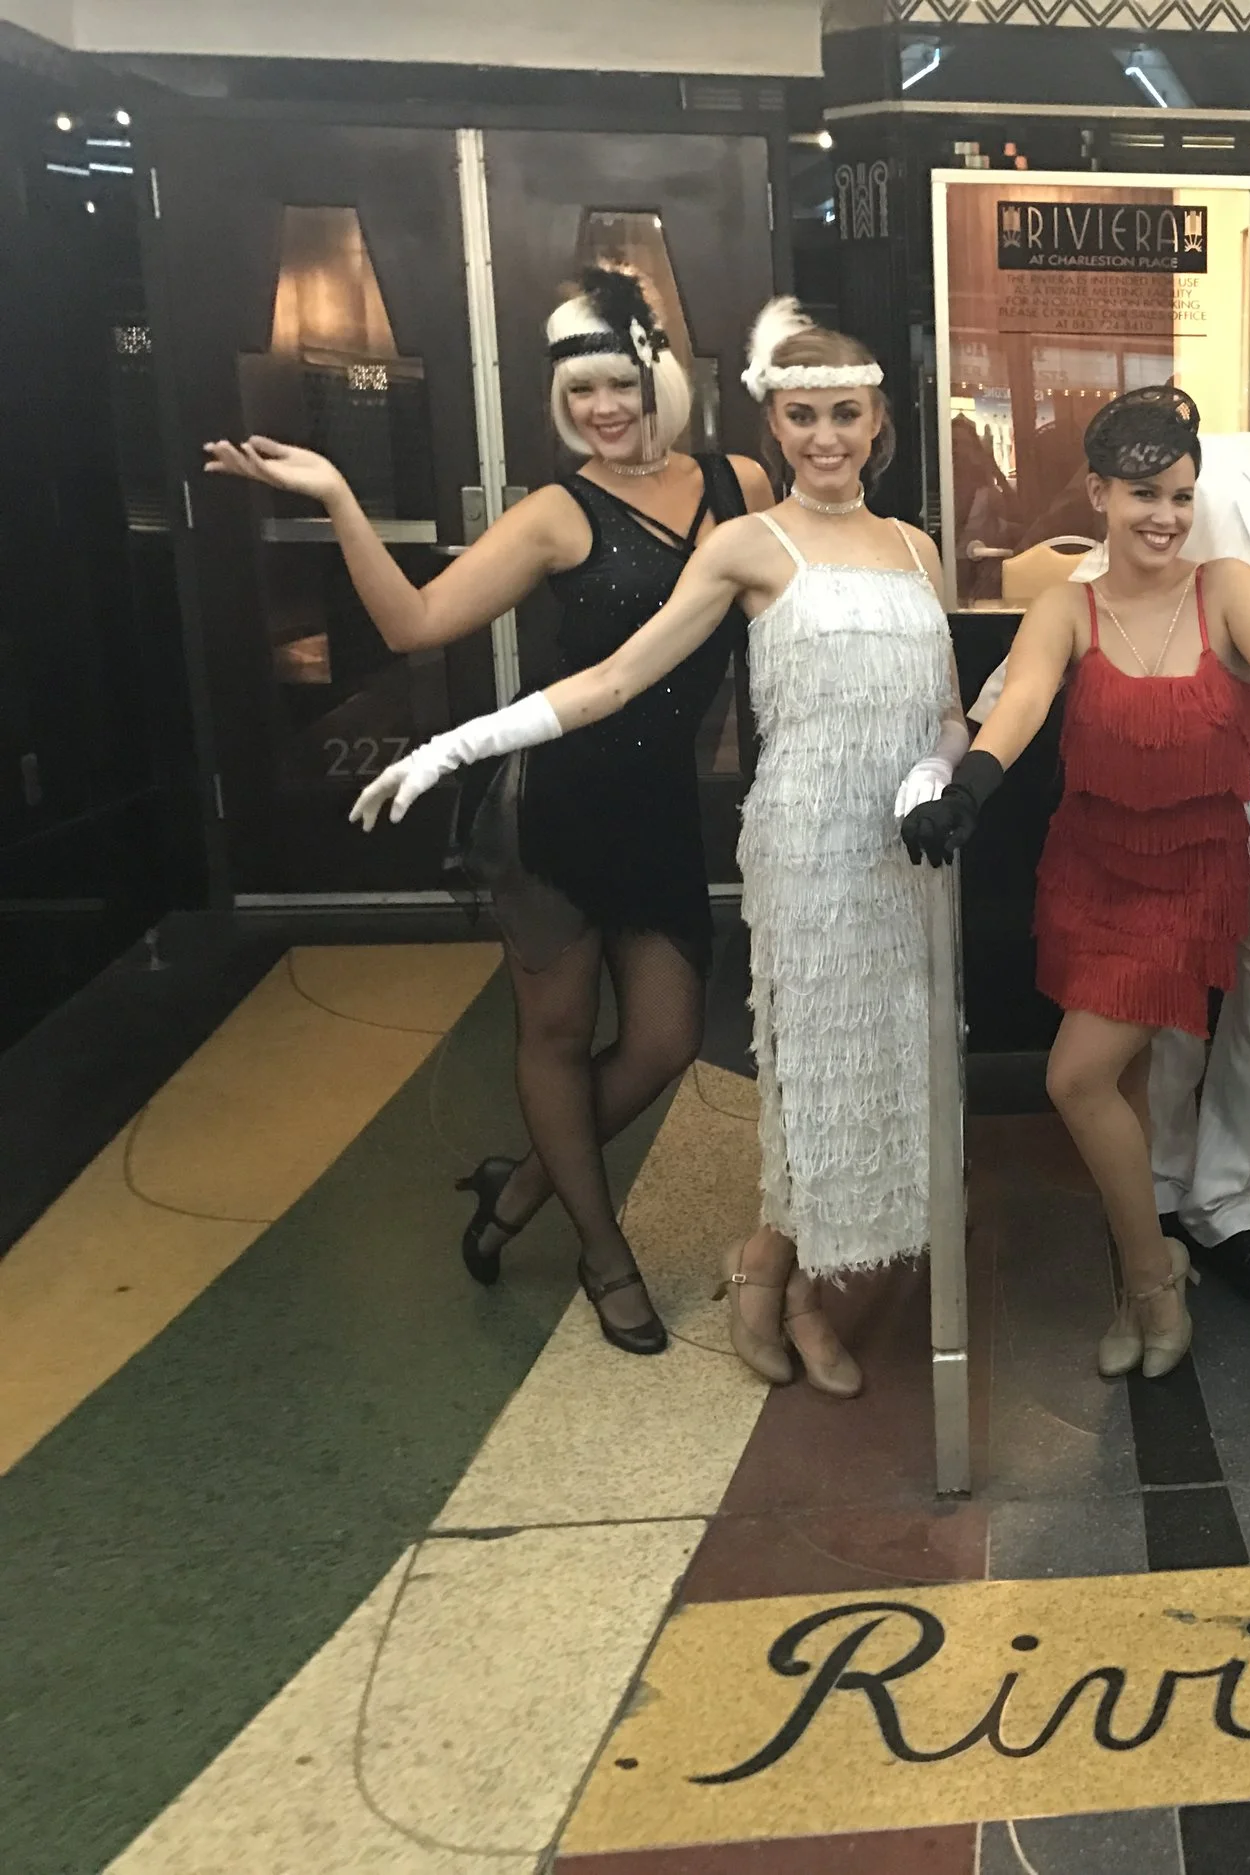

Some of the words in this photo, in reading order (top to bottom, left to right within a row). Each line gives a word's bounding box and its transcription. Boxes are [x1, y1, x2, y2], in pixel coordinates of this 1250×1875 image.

[1027, 206, 1178, 253] RIVIERA
[1028, 254, 1045, 265] AT
[1048, 254, 1136, 267] CHARLESTON
[1139, 256, 1178, 269] PLACE
[1007, 274, 1025, 284] THE
[1077, 276, 1087, 286] IS
[1178, 278, 1200, 288] USE
[1014, 285, 1029, 295] AS
[1033, 286, 1042, 295] A
[1092, 287, 1141, 298] MEETING
[1101, 309, 1128, 319] OUR
[1168, 310, 1207, 321] OFFICE
[1055, 319, 1068, 329] AT
[323, 737, 410, 776] 227
